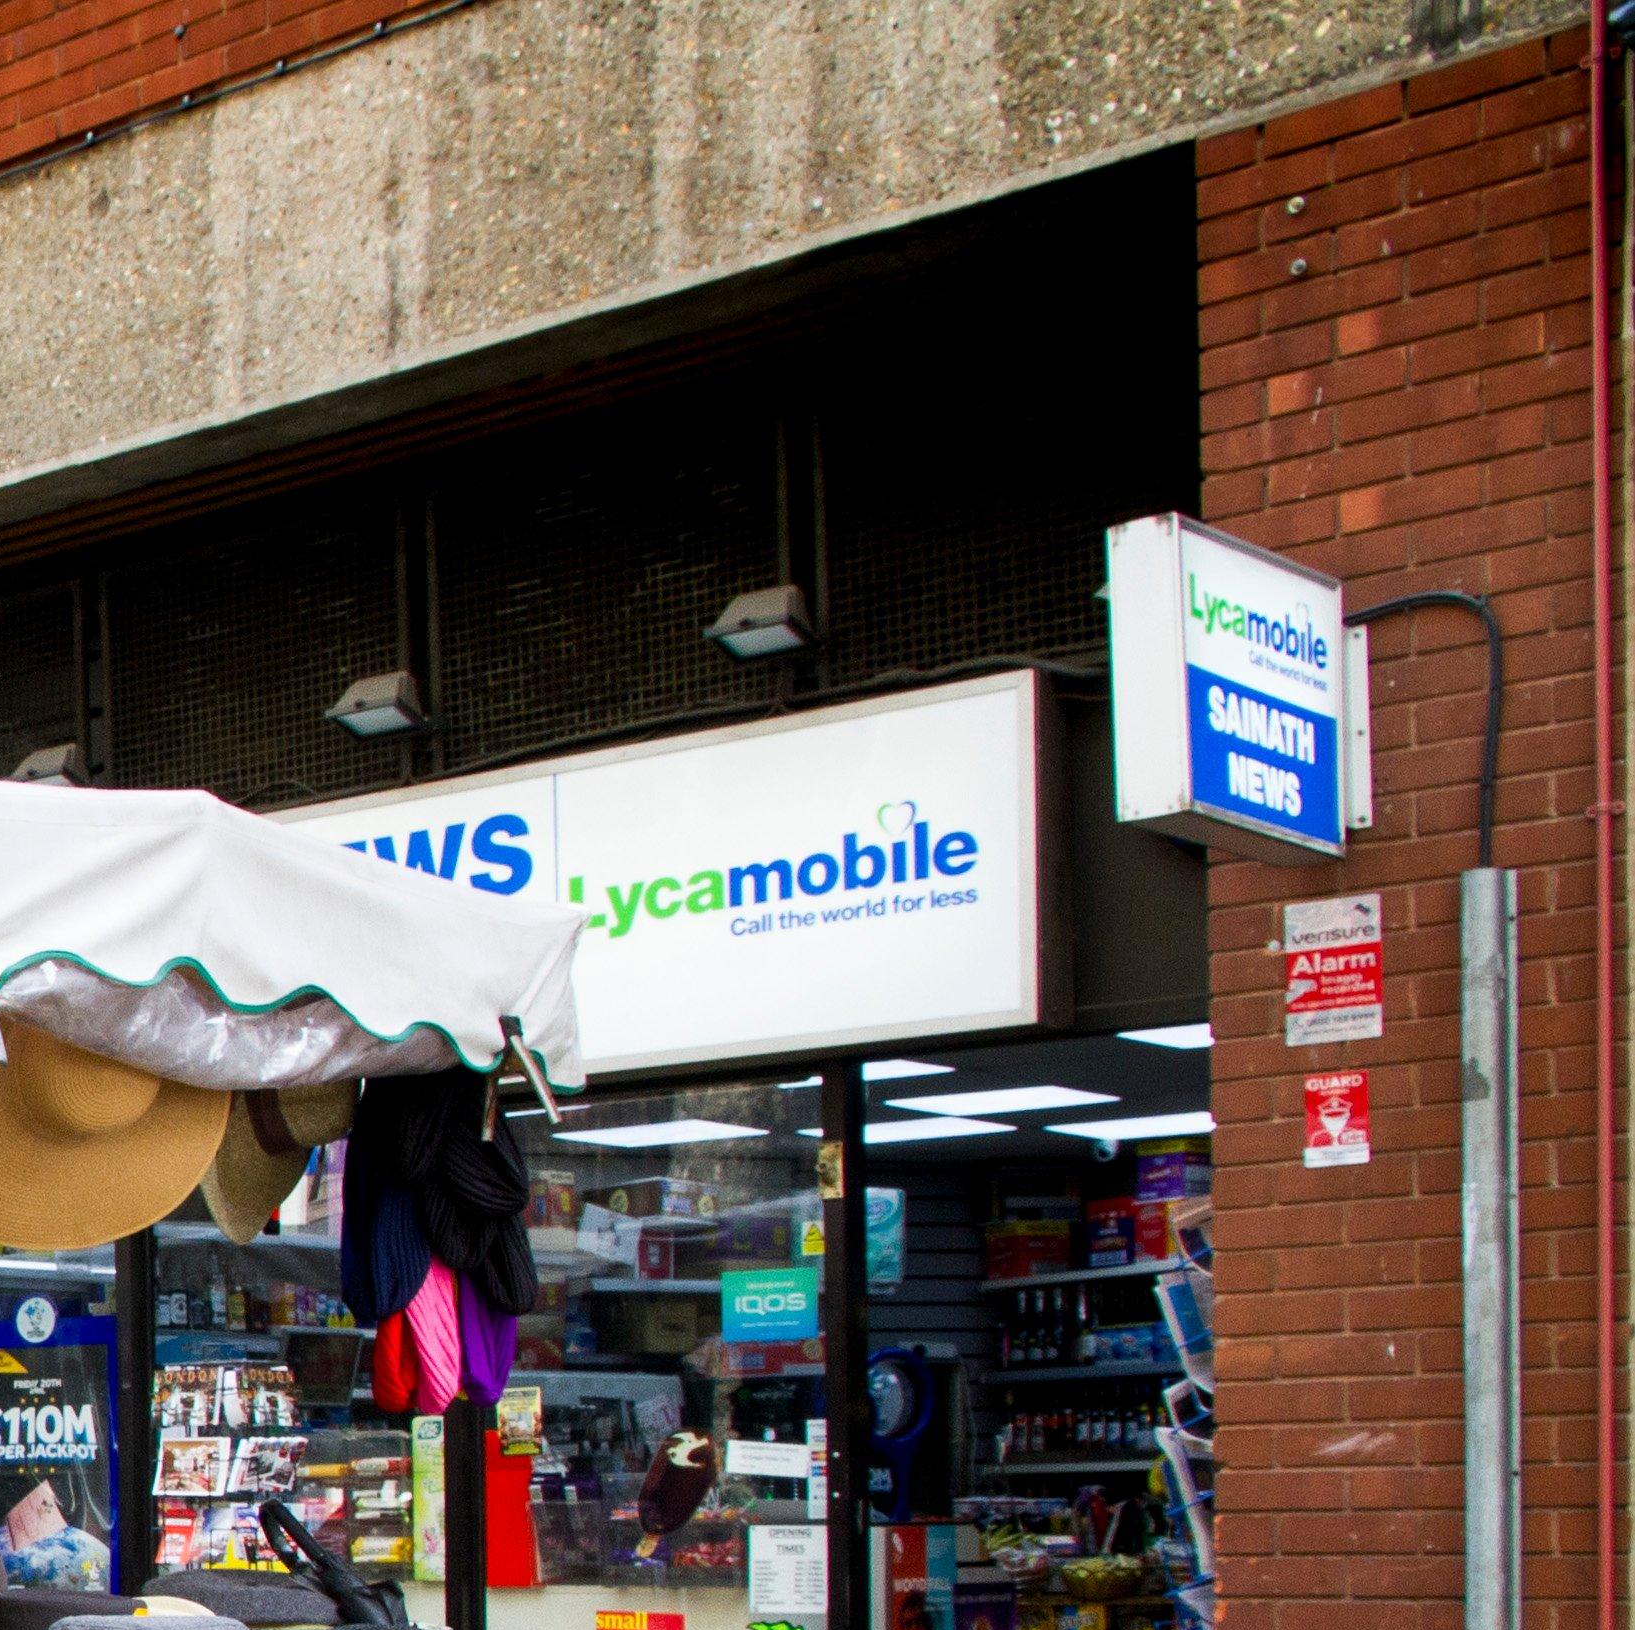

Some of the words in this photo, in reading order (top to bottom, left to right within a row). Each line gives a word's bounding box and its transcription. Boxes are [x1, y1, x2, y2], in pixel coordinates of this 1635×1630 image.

[1189, 573, 1328, 669] Lycamobile
[1208, 685, 1316, 765] SAINATH
[1228, 751, 1303, 817] NEWS
[340, 813, 533, 896] WS
[568, 821, 978, 939] Lycamobile
[730, 914, 772, 936] Call
[779, 909, 816, 928] the
[821, 900, 886, 923] world
[893, 894, 926, 913] for
[929, 886, 978, 909] less
[1291, 950, 1378, 977] Alarm
[734, 1292, 807, 1316] IQOS
[27, 1444, 97, 1460] JACKPOT
[596, 1611, 648, 1630] small
